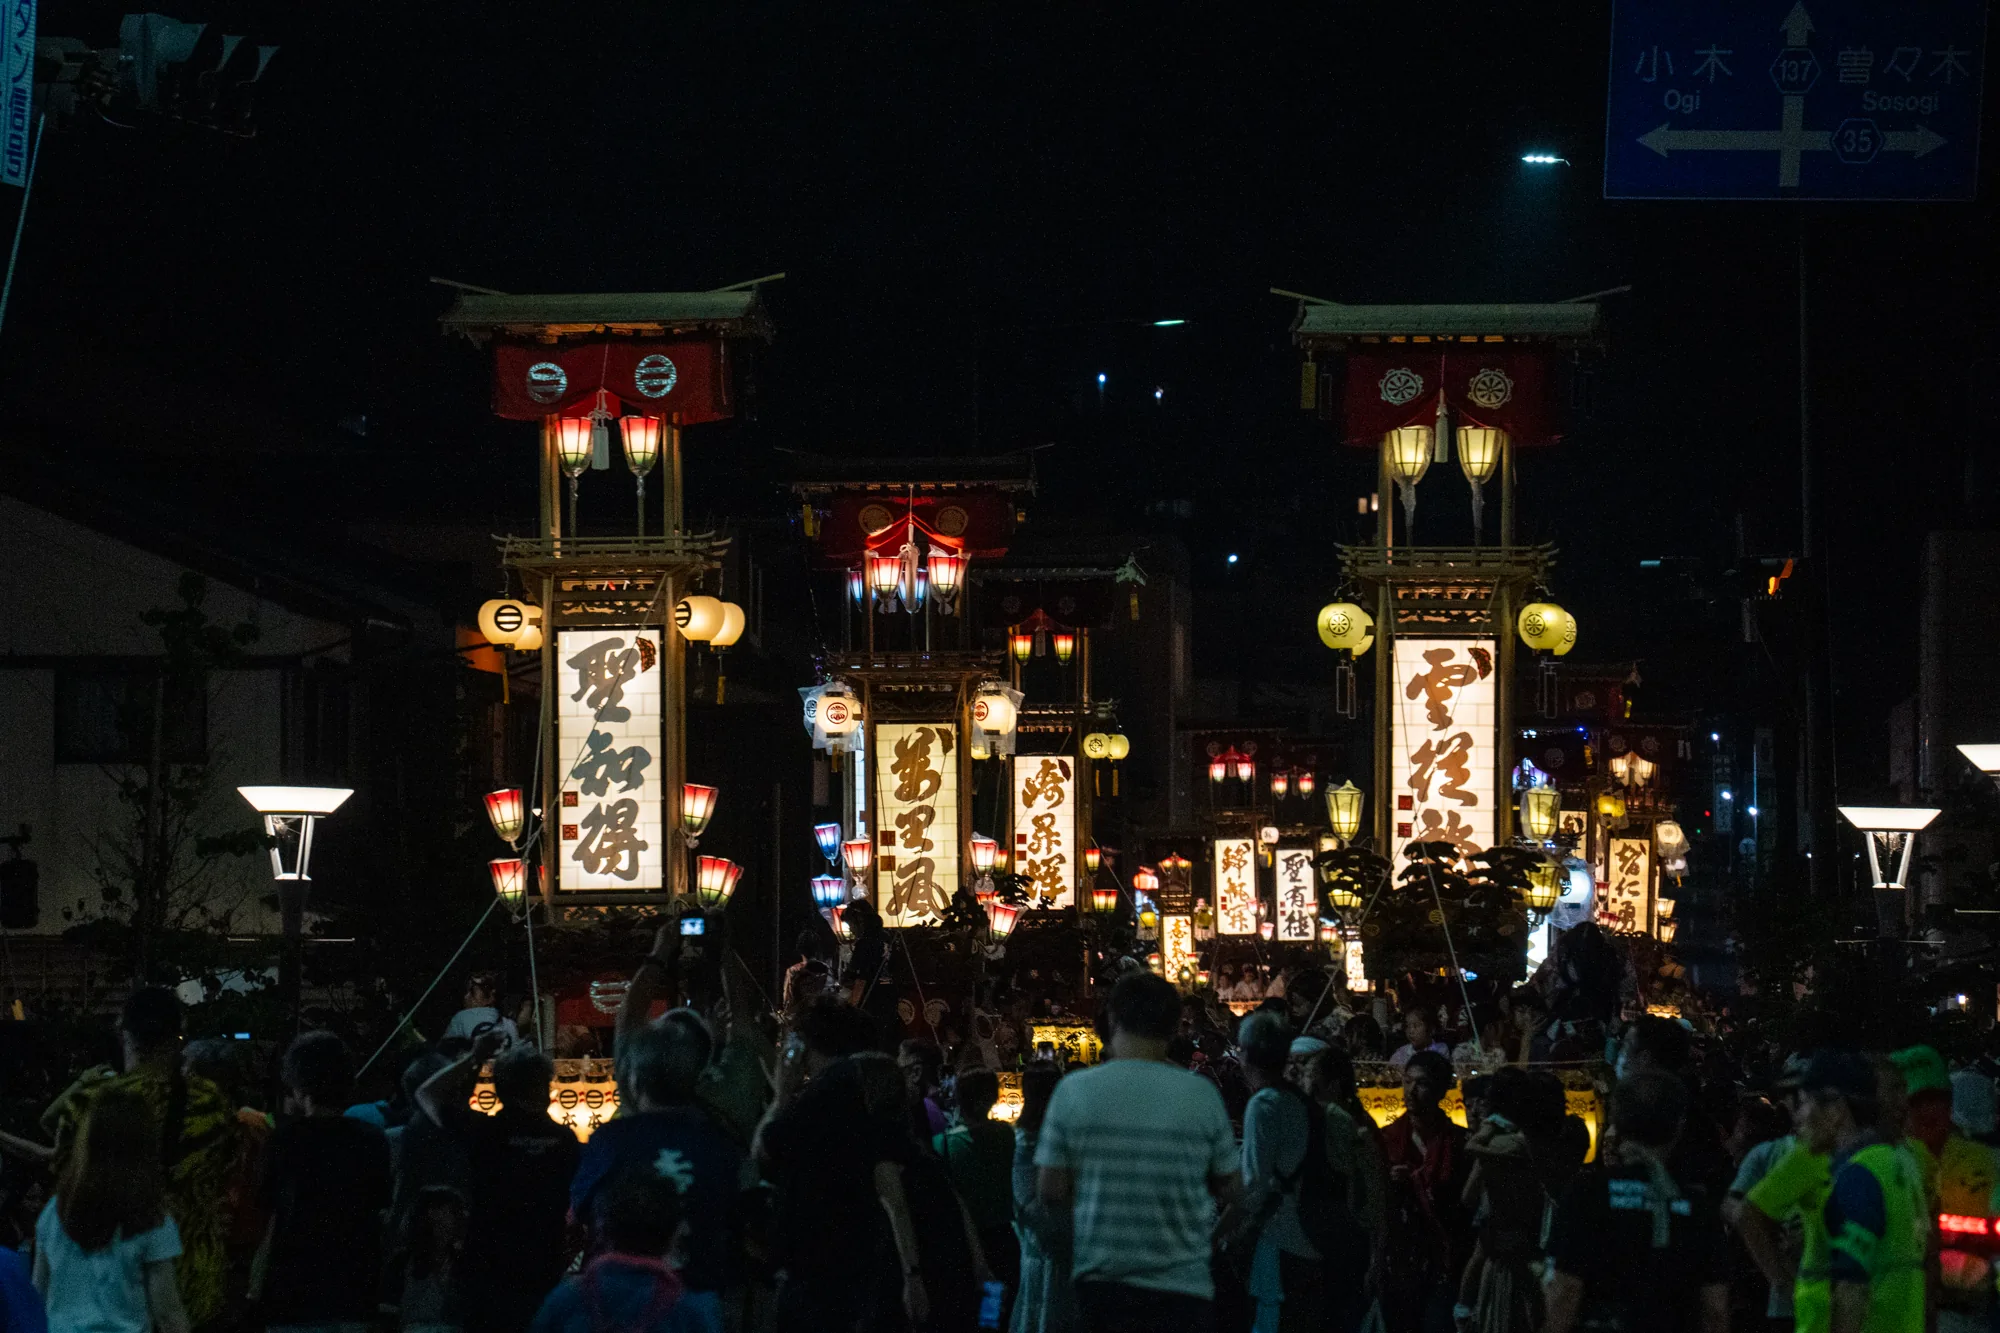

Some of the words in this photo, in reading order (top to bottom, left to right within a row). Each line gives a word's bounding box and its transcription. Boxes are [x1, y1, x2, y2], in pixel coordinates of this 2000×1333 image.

[1634, 45, 1733, 83] 小木
[1779, 59, 1811, 83] 137
[1664, 89, 1701, 115] Ogi
[1863, 90, 1941, 114] Sosogi
[1843, 129, 1872, 154] 35
